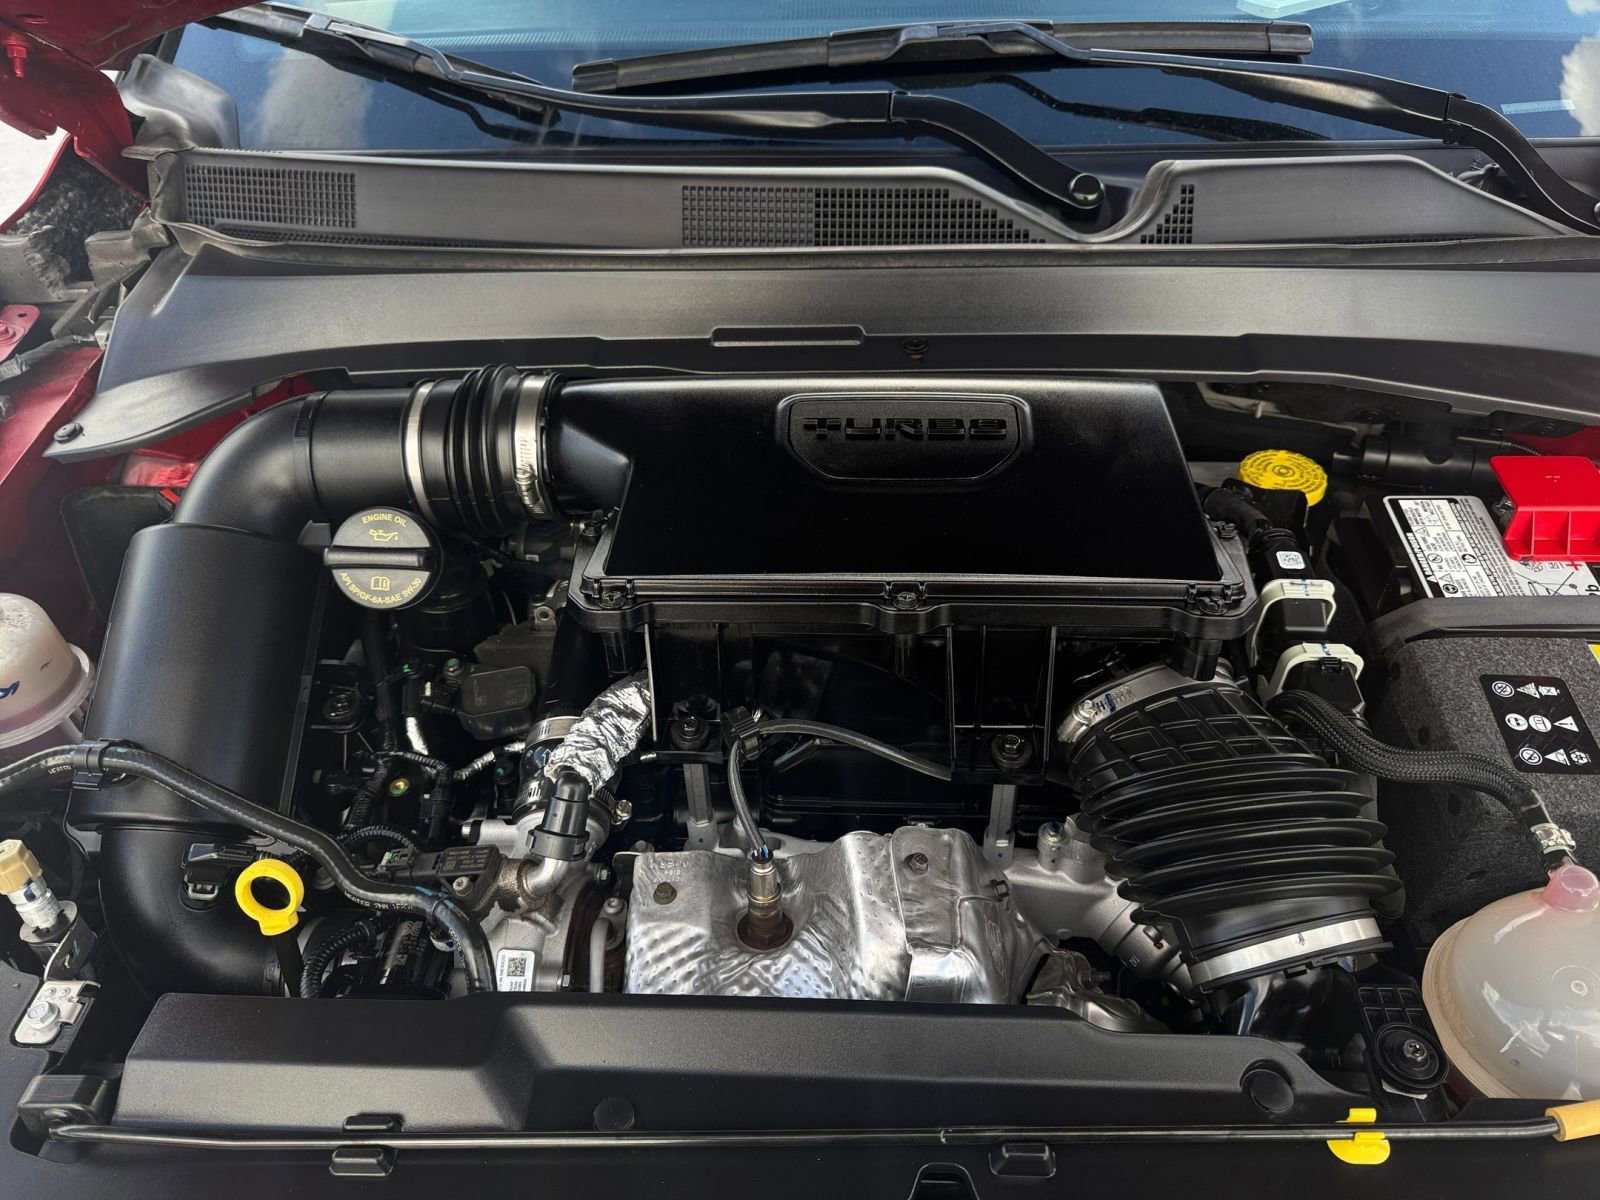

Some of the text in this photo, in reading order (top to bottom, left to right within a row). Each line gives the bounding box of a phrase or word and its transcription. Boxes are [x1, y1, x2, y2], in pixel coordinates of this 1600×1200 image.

[801, 417, 1008, 440] TURBO
[361, 512, 407, 528] ENGINE OIL
[340, 572, 351, 587] API
[402, 577, 422, 599] 5W-30
